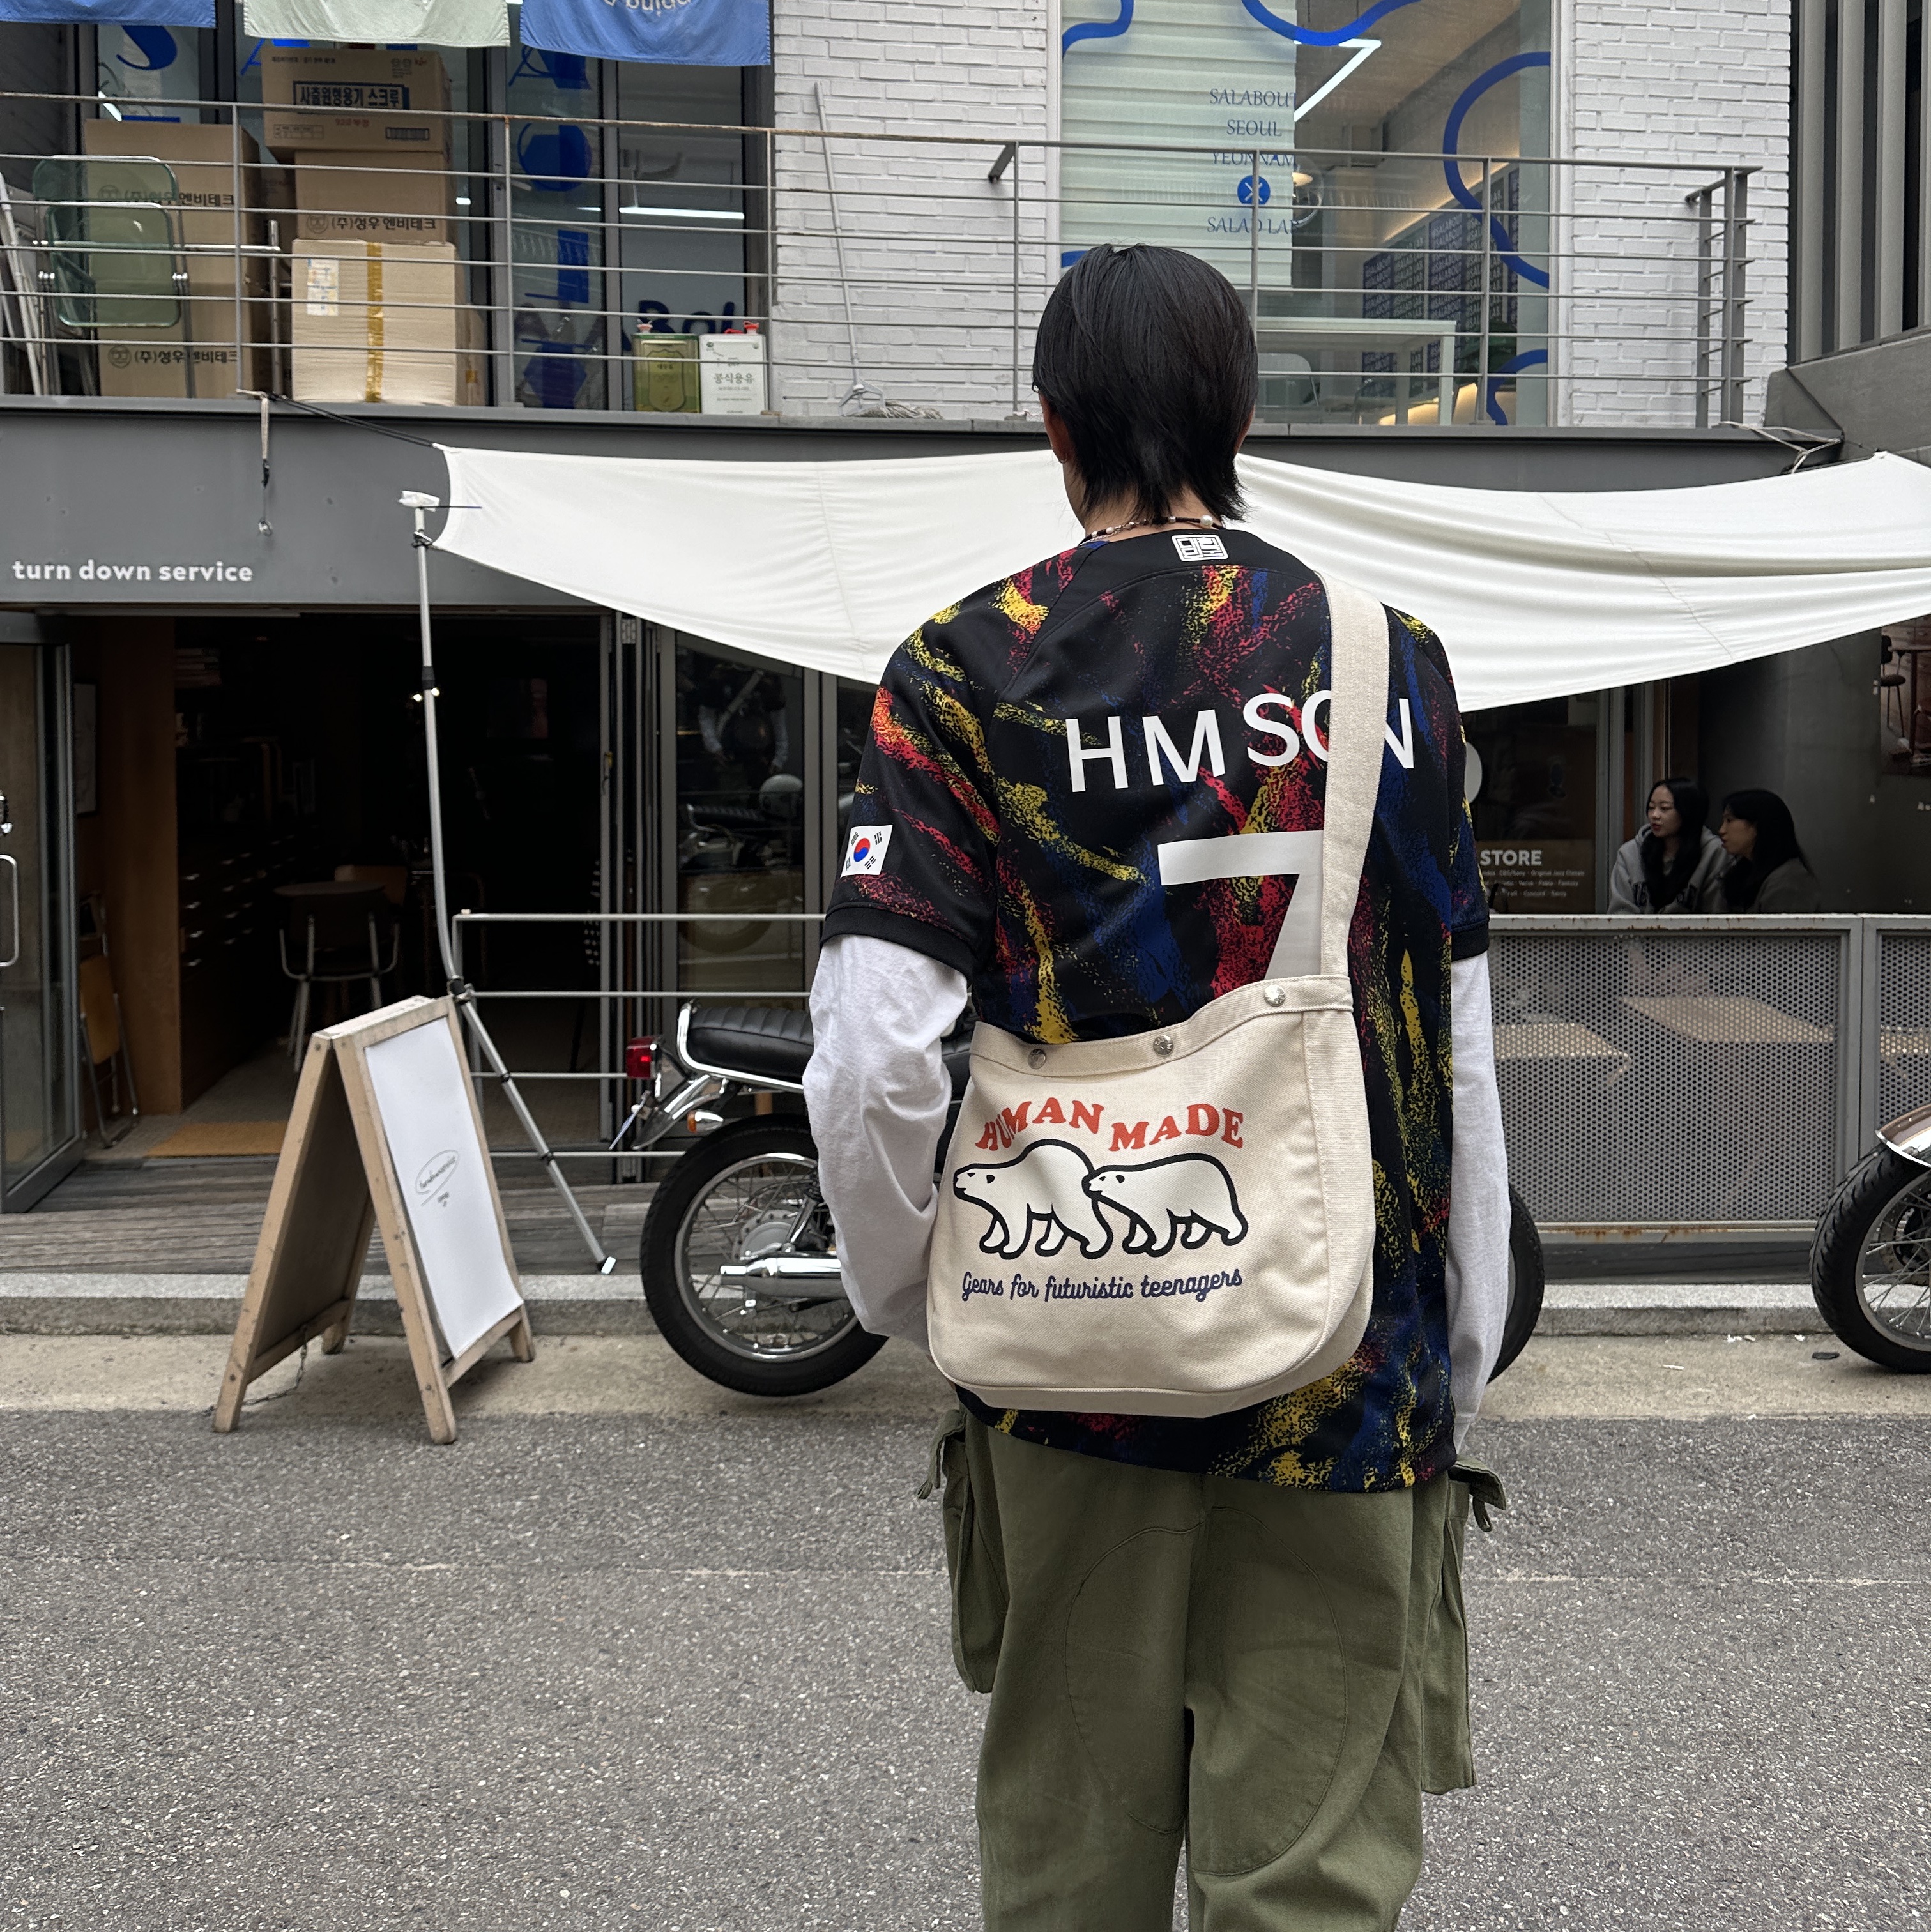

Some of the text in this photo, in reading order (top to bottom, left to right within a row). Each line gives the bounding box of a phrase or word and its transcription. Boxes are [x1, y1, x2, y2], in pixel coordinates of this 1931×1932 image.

[1209, 88, 1297, 107] SALABOUT
[1226, 119, 1282, 137] SEOUL
[12, 559, 254, 582] turn down service
[1479, 849, 1542, 866] STORE
[1158, 830, 1324, 980] 7
[1108, 1103, 1244, 1151] MADE
[961, 1268, 1242, 1302] Gears for futuristic teenagers
